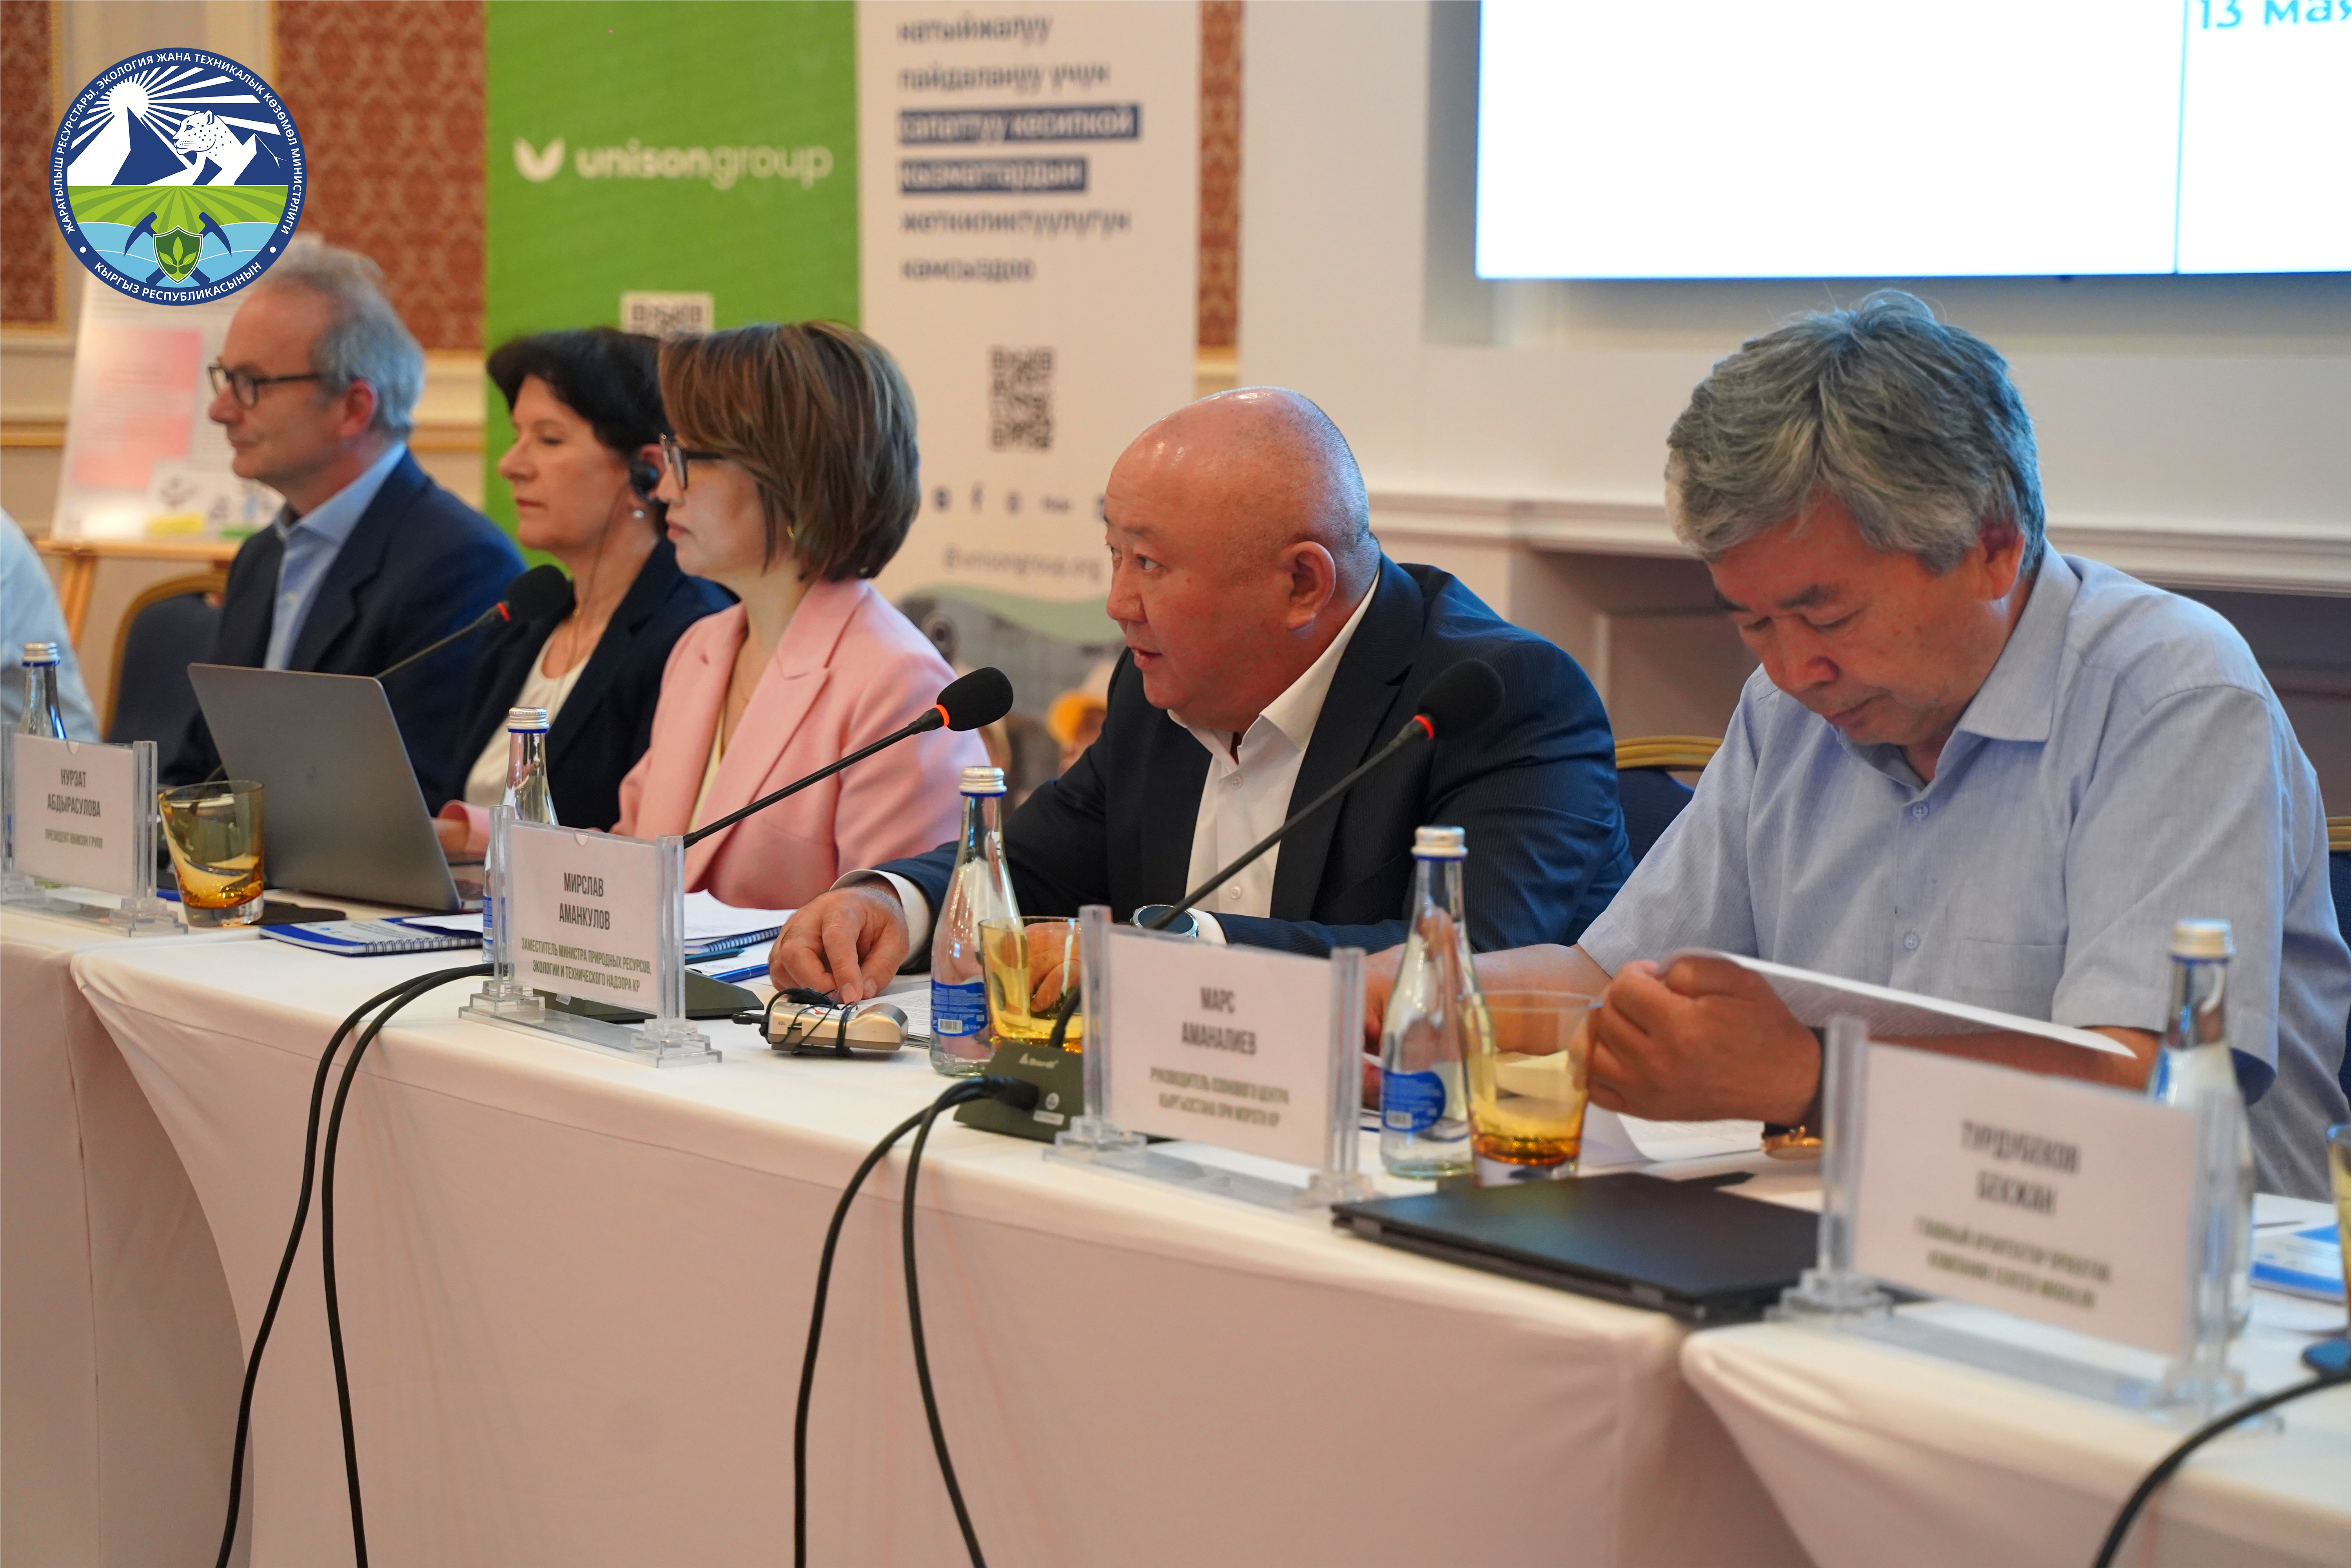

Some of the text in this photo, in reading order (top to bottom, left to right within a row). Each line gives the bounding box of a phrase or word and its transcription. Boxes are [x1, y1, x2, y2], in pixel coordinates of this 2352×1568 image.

[574, 136, 835, 191] unisongroup
[60, 768, 86, 788] НУРЗАТ
[47, 793, 101, 818] АБДЫРАСУЛОВА
[564, 872, 604, 897] МИРСЛАВ
[559, 903, 610, 930] АМАНКУЛОВ
[521, 937, 652, 976] ЗАМЕСТИТЕЛЬ МИНИСТРА ПРИРОДНЫХ РЕСУРСОВ,
[532, 959, 640, 992] ЭКОЛОГИИ И ТЕХНИЧЕСКОГО НАДЗОРА КР
[1200, 985, 1236, 1014] МАРС
[1181, 1021, 1258, 1056] АМАНАЛИЕВ
